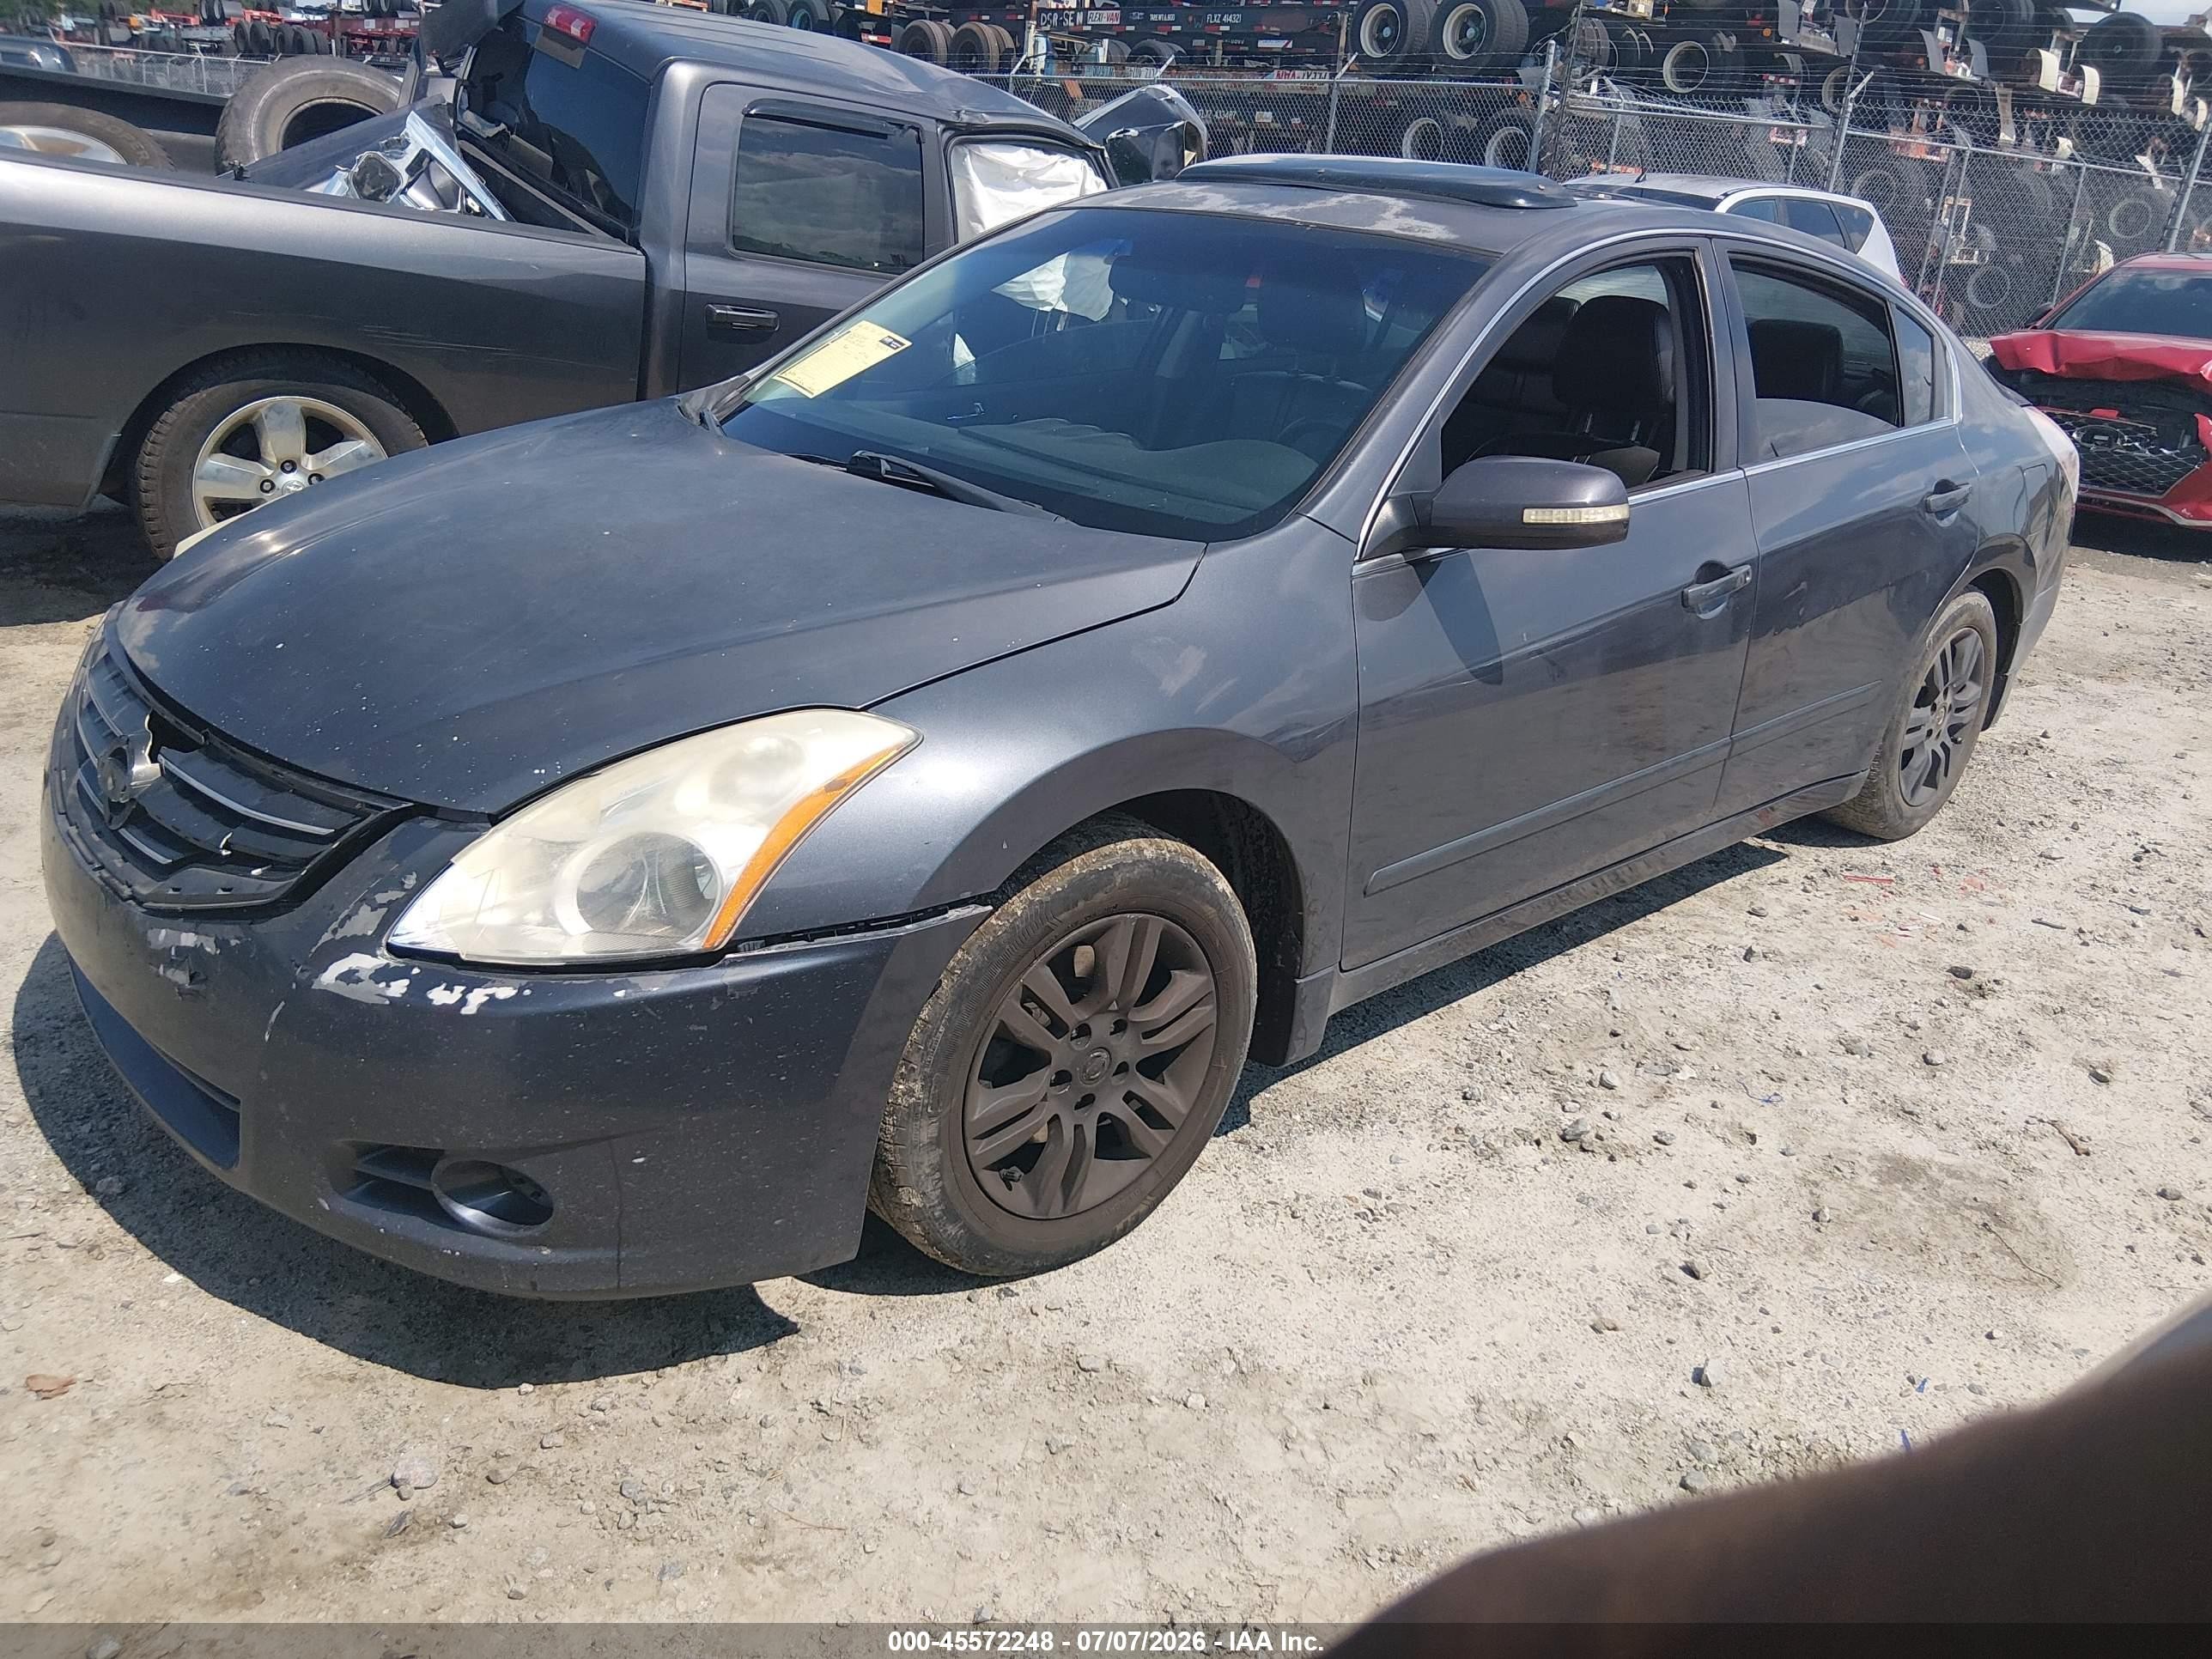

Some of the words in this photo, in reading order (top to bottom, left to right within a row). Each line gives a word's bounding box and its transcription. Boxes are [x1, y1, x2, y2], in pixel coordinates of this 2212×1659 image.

[1088, 12, 1120, 22] FLEXI-VAN
[1206, 14, 1221, 23] FLXZ
[1222, 14, 1242, 23] 414321
